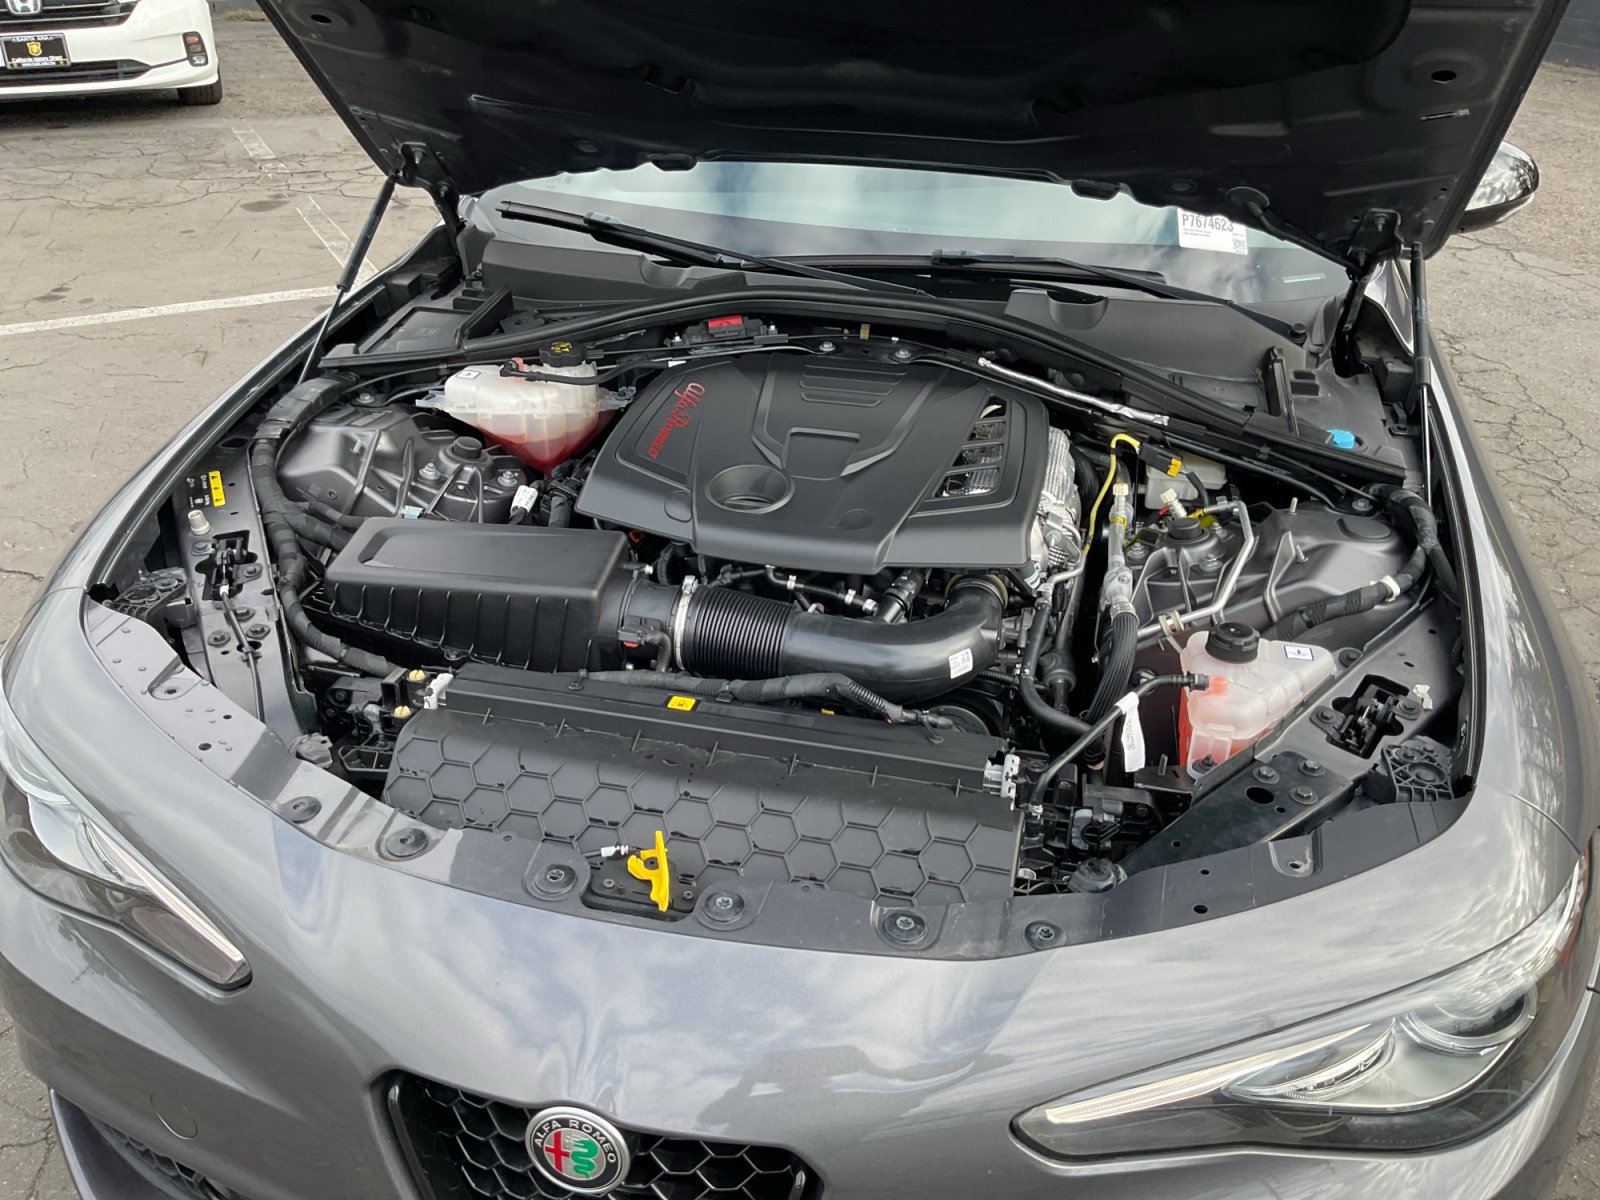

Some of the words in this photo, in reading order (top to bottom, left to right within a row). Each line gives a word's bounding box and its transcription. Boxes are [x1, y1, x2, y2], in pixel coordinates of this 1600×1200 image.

[647, 409, 692, 460] Romeo
[534, 1120, 562, 1147] ALFA
[568, 1119, 617, 1163] ROMEO
